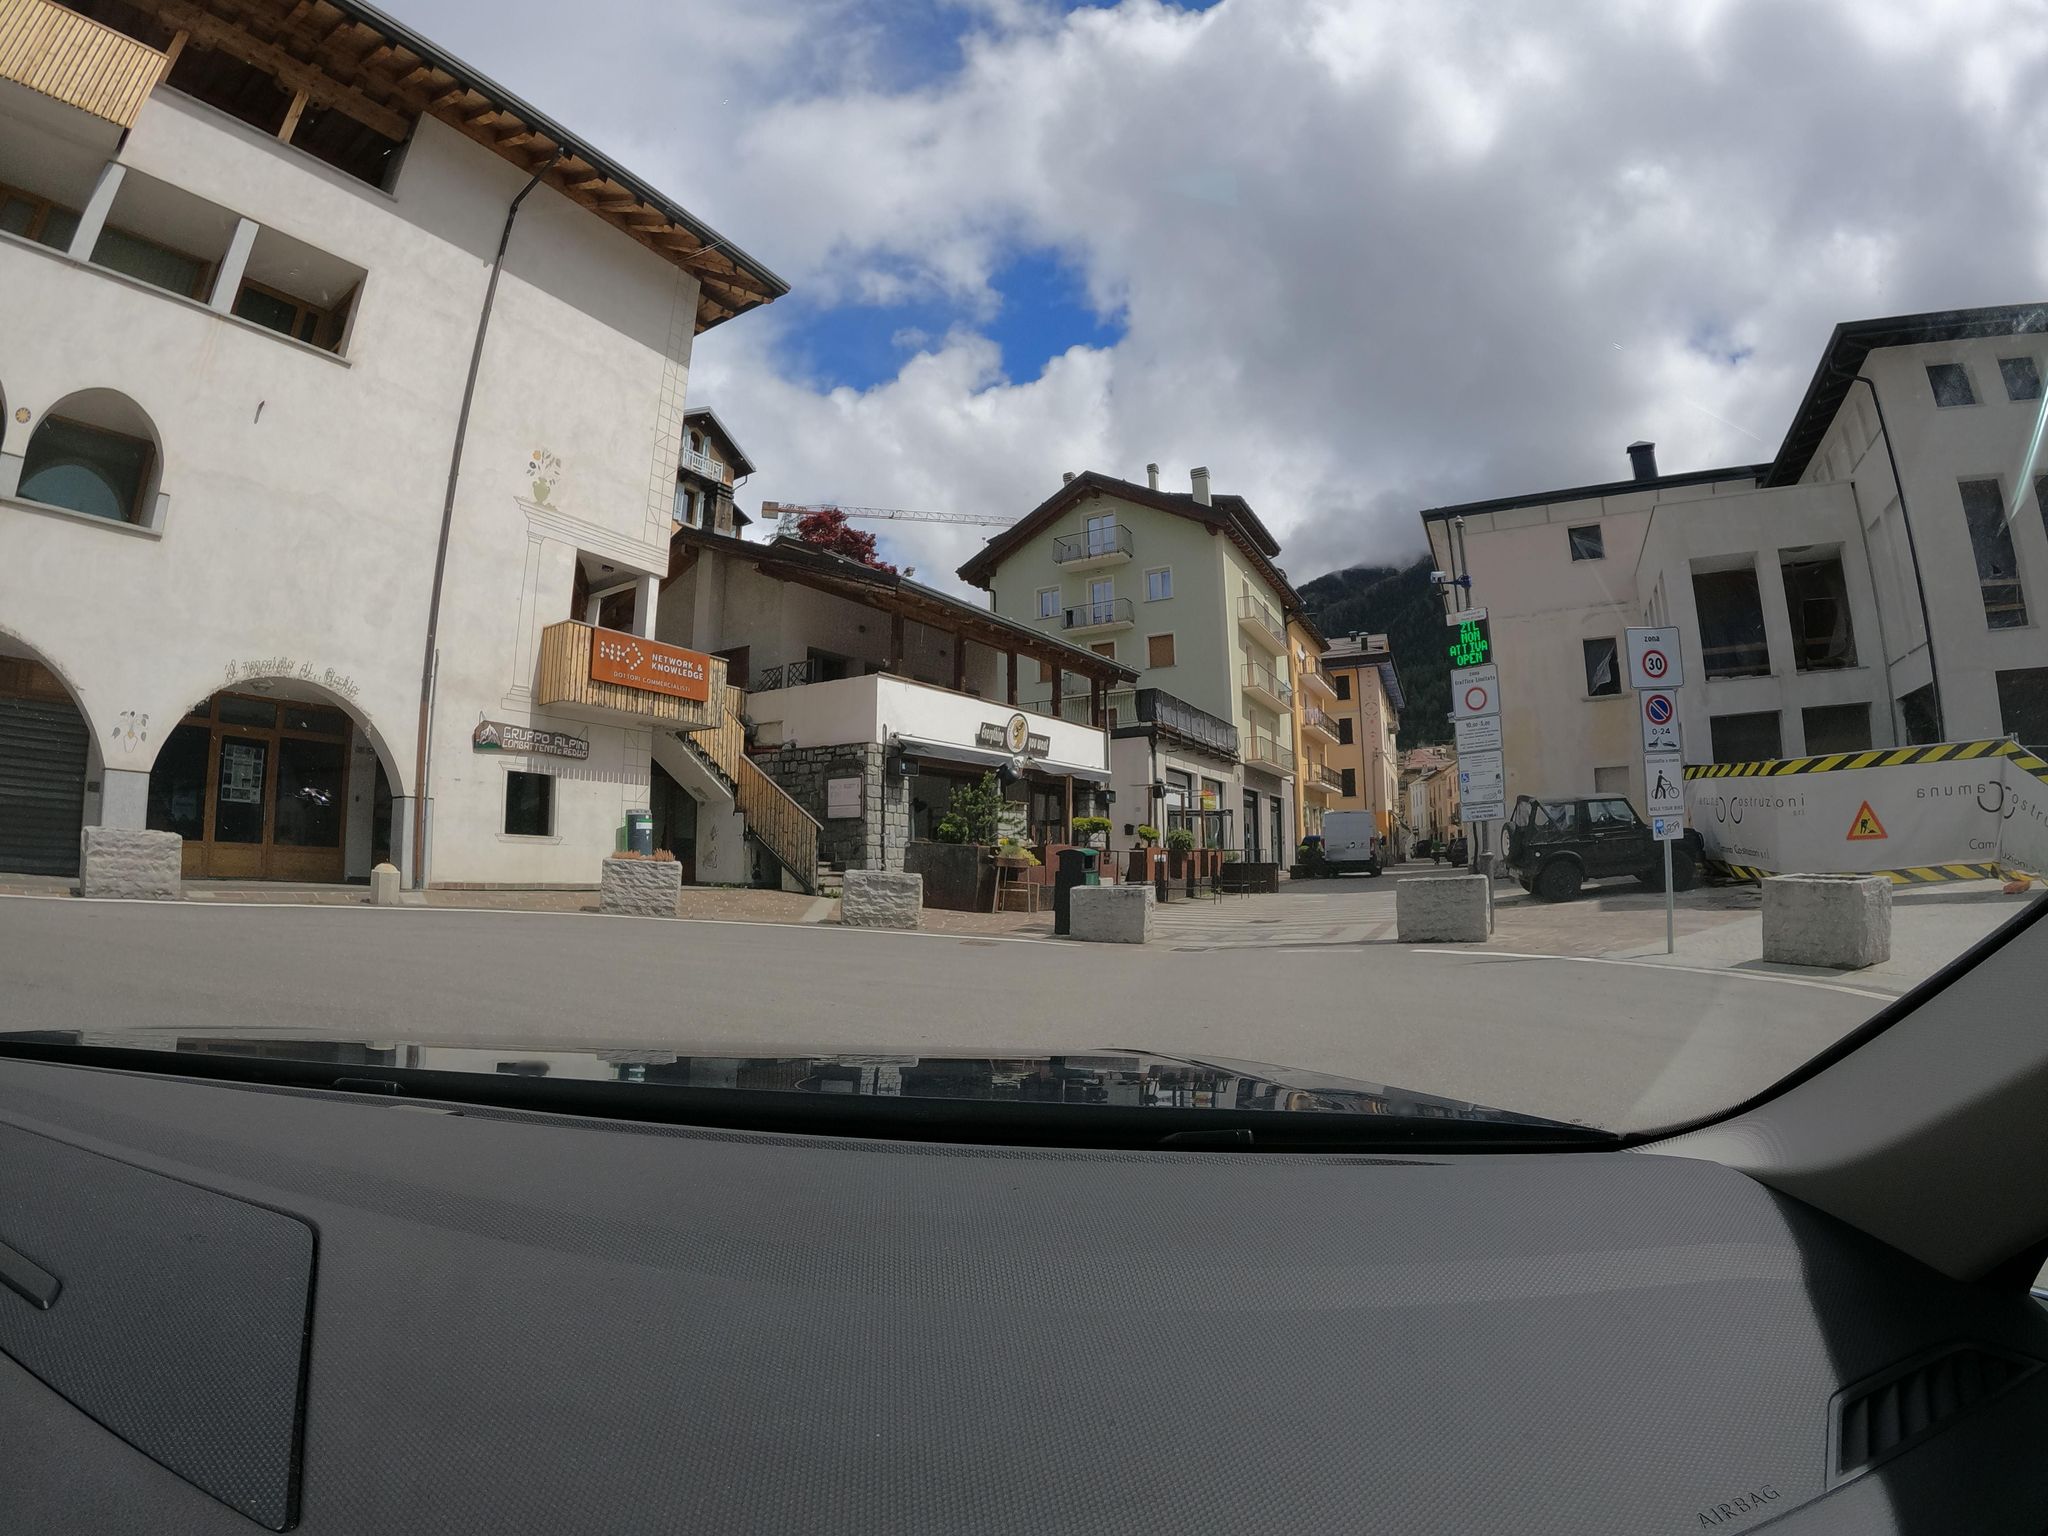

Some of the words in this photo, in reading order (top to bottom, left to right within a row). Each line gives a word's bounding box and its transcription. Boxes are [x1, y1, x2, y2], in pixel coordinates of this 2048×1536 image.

[652, 653, 693, 670] NETWORK
[697, 663, 703, 672] &
[1457, 652, 1483, 666] OPEN
[1648, 657, 1662, 671] 30
[651, 662, 704, 681] KNOWLEDGE
[613, 671, 640, 682] DOTTORI
[642, 677, 692, 692] COMMERCIALISTI
[502, 738, 557, 754] COMBATTENTI
[503, 726, 550, 744] GRUPPO
[554, 736, 588, 751] ALPINI
[1697, 1484, 1781, 1529] AIRBAG
